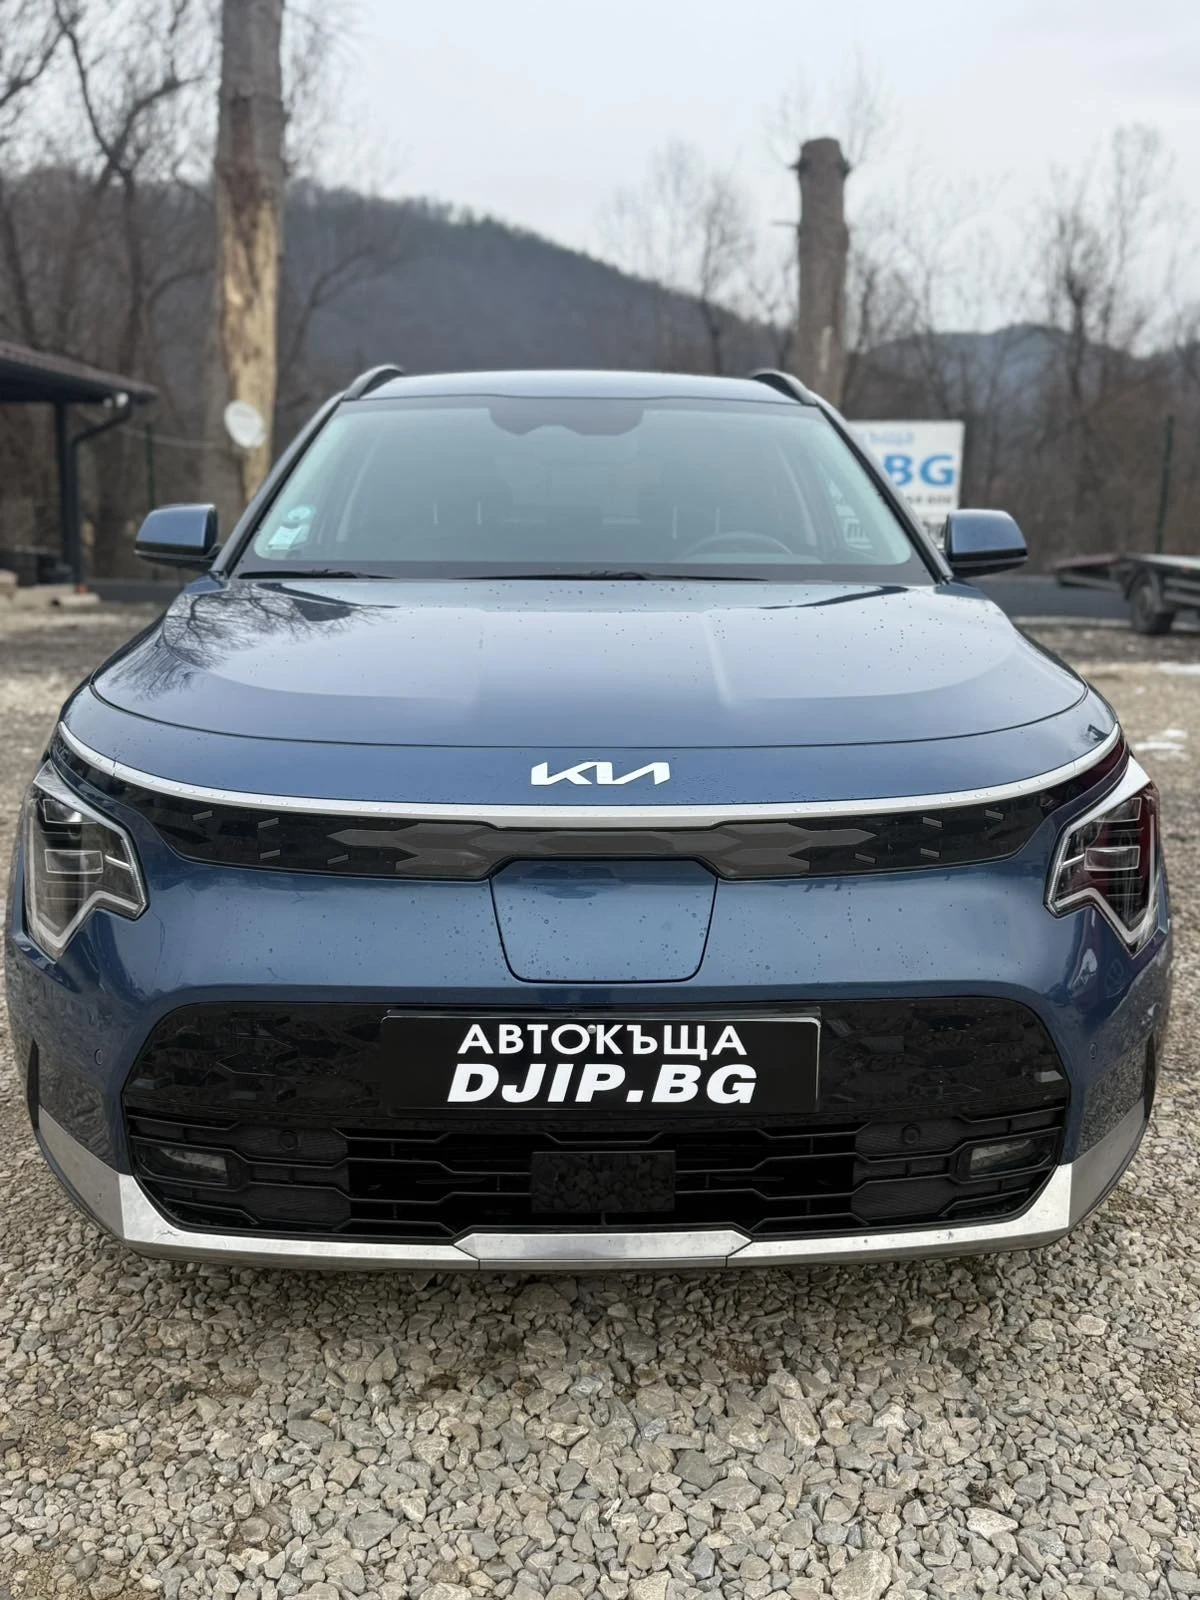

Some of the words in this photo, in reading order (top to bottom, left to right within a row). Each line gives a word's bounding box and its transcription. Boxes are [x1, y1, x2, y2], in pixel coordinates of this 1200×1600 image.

[530, 761, 671, 786] KIA
[457, 1023, 747, 1061] АВТОКЪЩА
[447, 1063, 757, 1104] DJIP.BG
